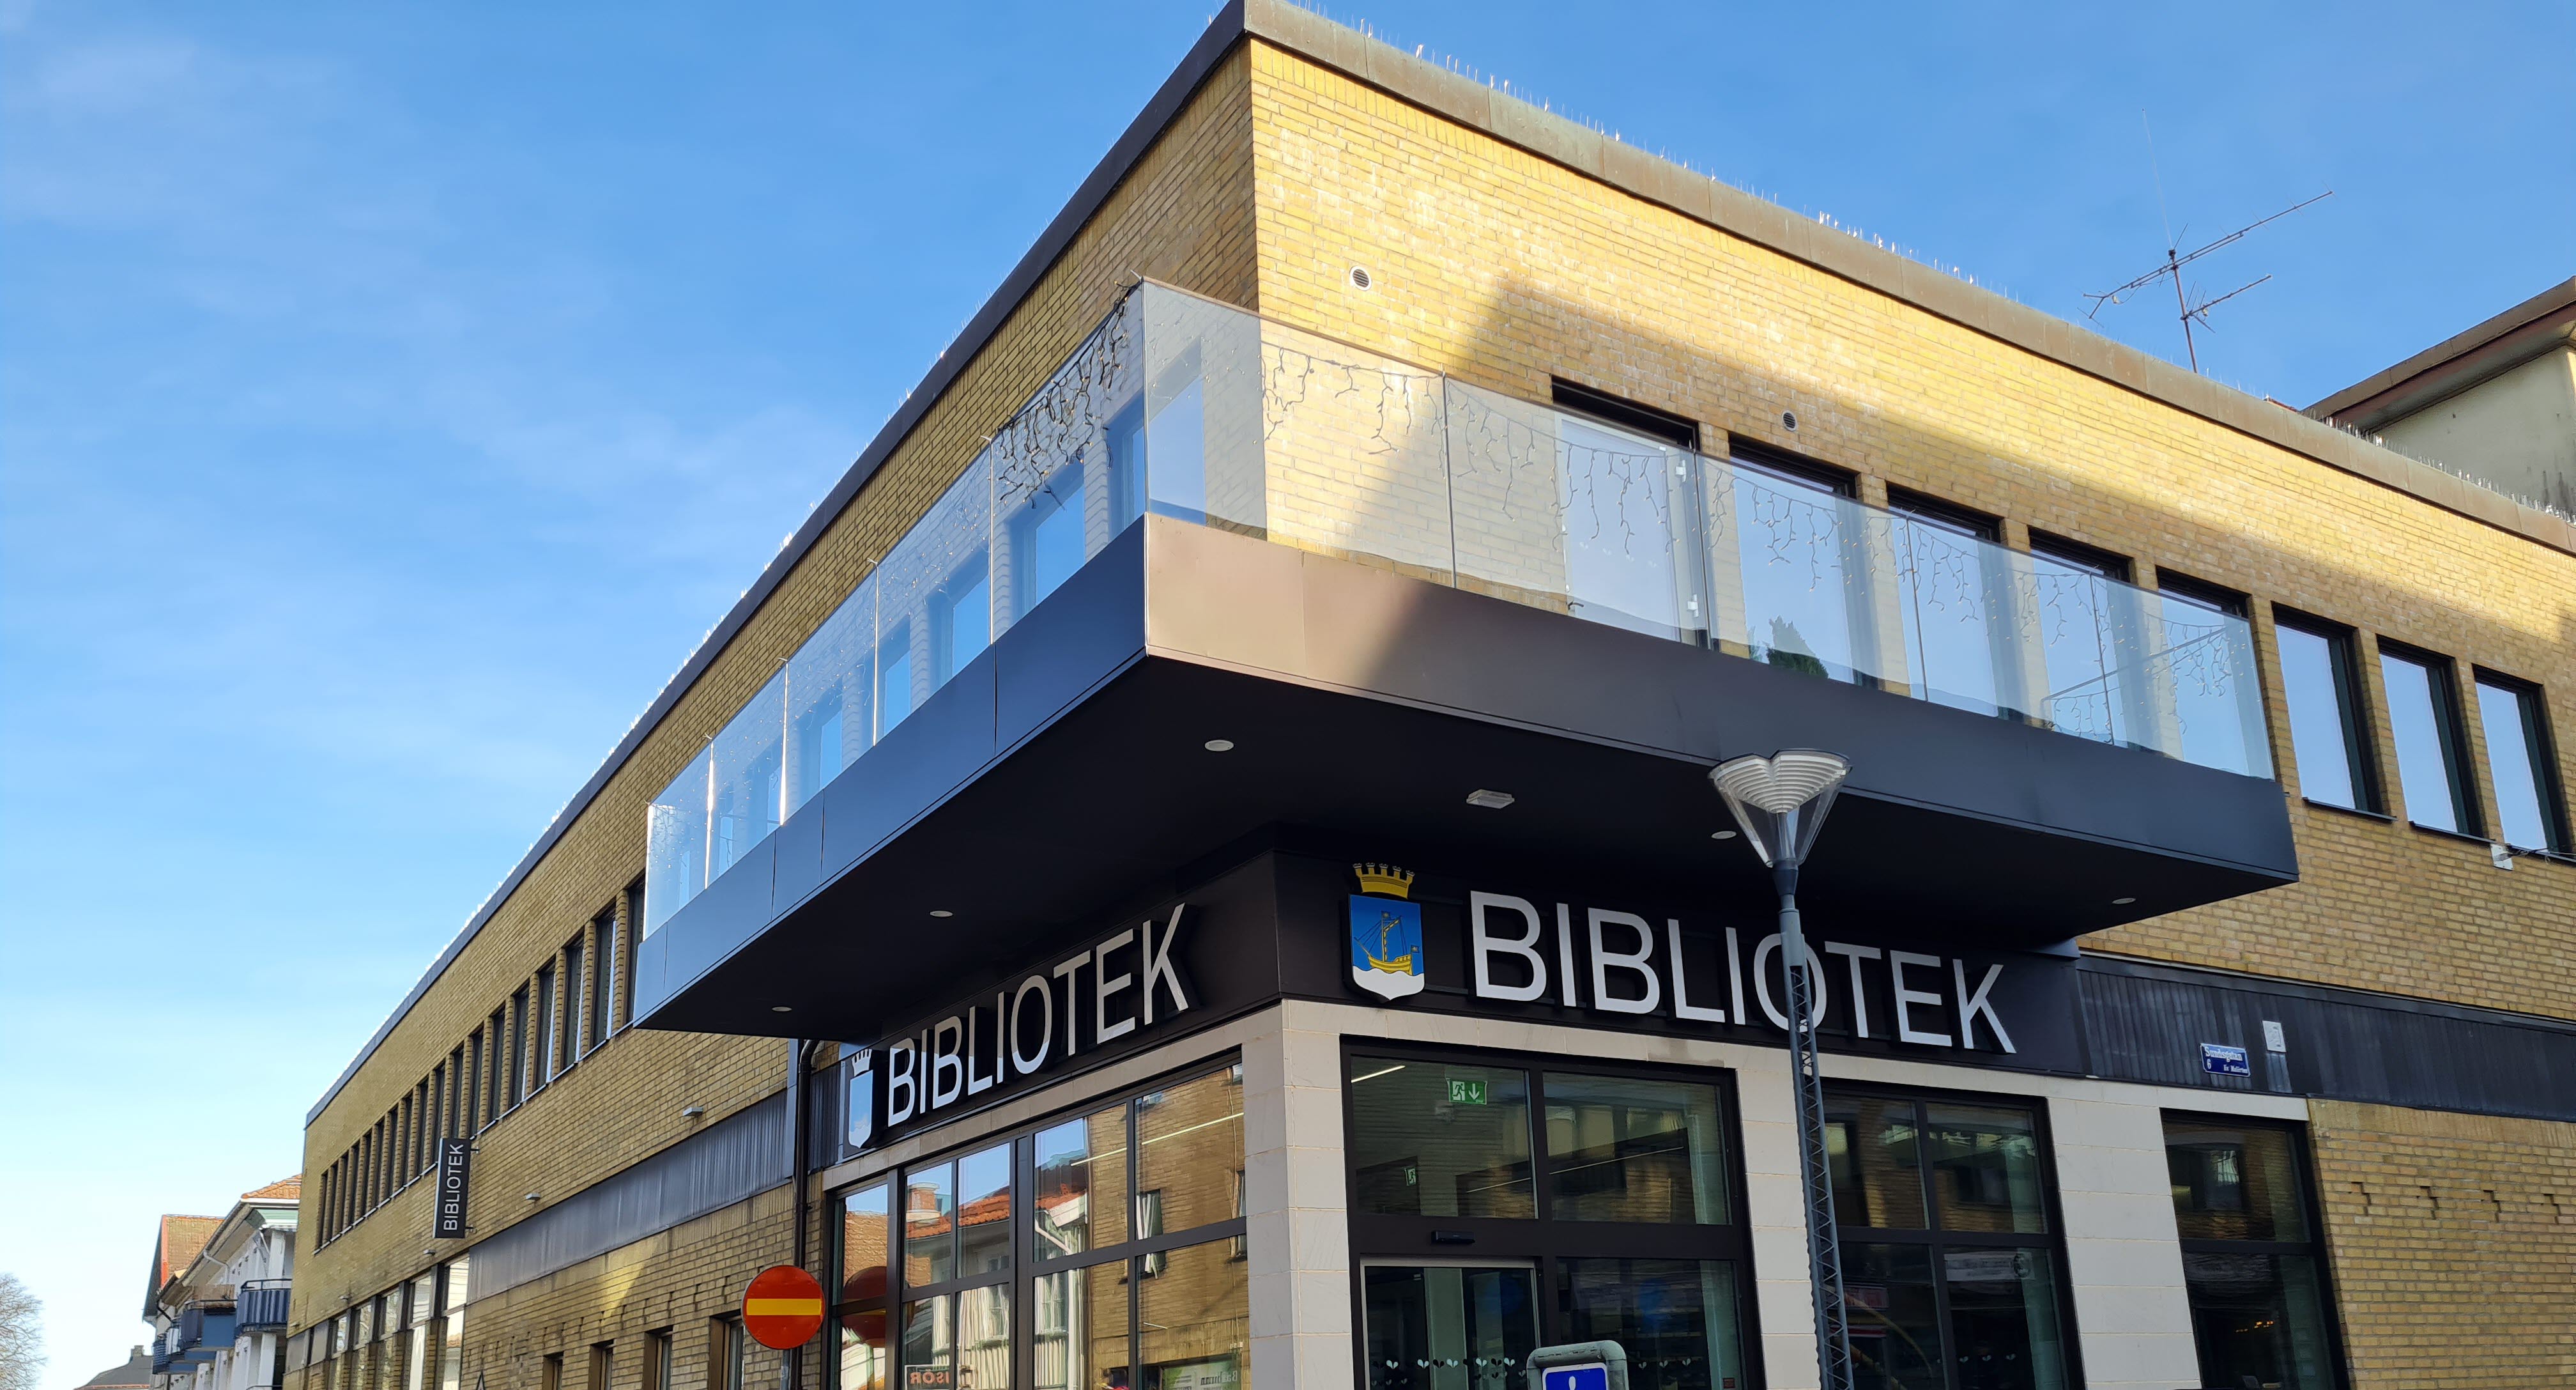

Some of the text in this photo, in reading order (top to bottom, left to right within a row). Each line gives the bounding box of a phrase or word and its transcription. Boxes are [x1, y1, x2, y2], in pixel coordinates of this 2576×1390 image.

[888, 902, 1188, 1127] BIBLIOTEK
[1470, 890, 2017, 1054] BIBLIOTEK
[2205, 1046, 2243, 1062] Sundsgatan
[2207, 1058, 2212, 1069] 6
[443, 1144, 464, 1230] BIBLIOTEK
